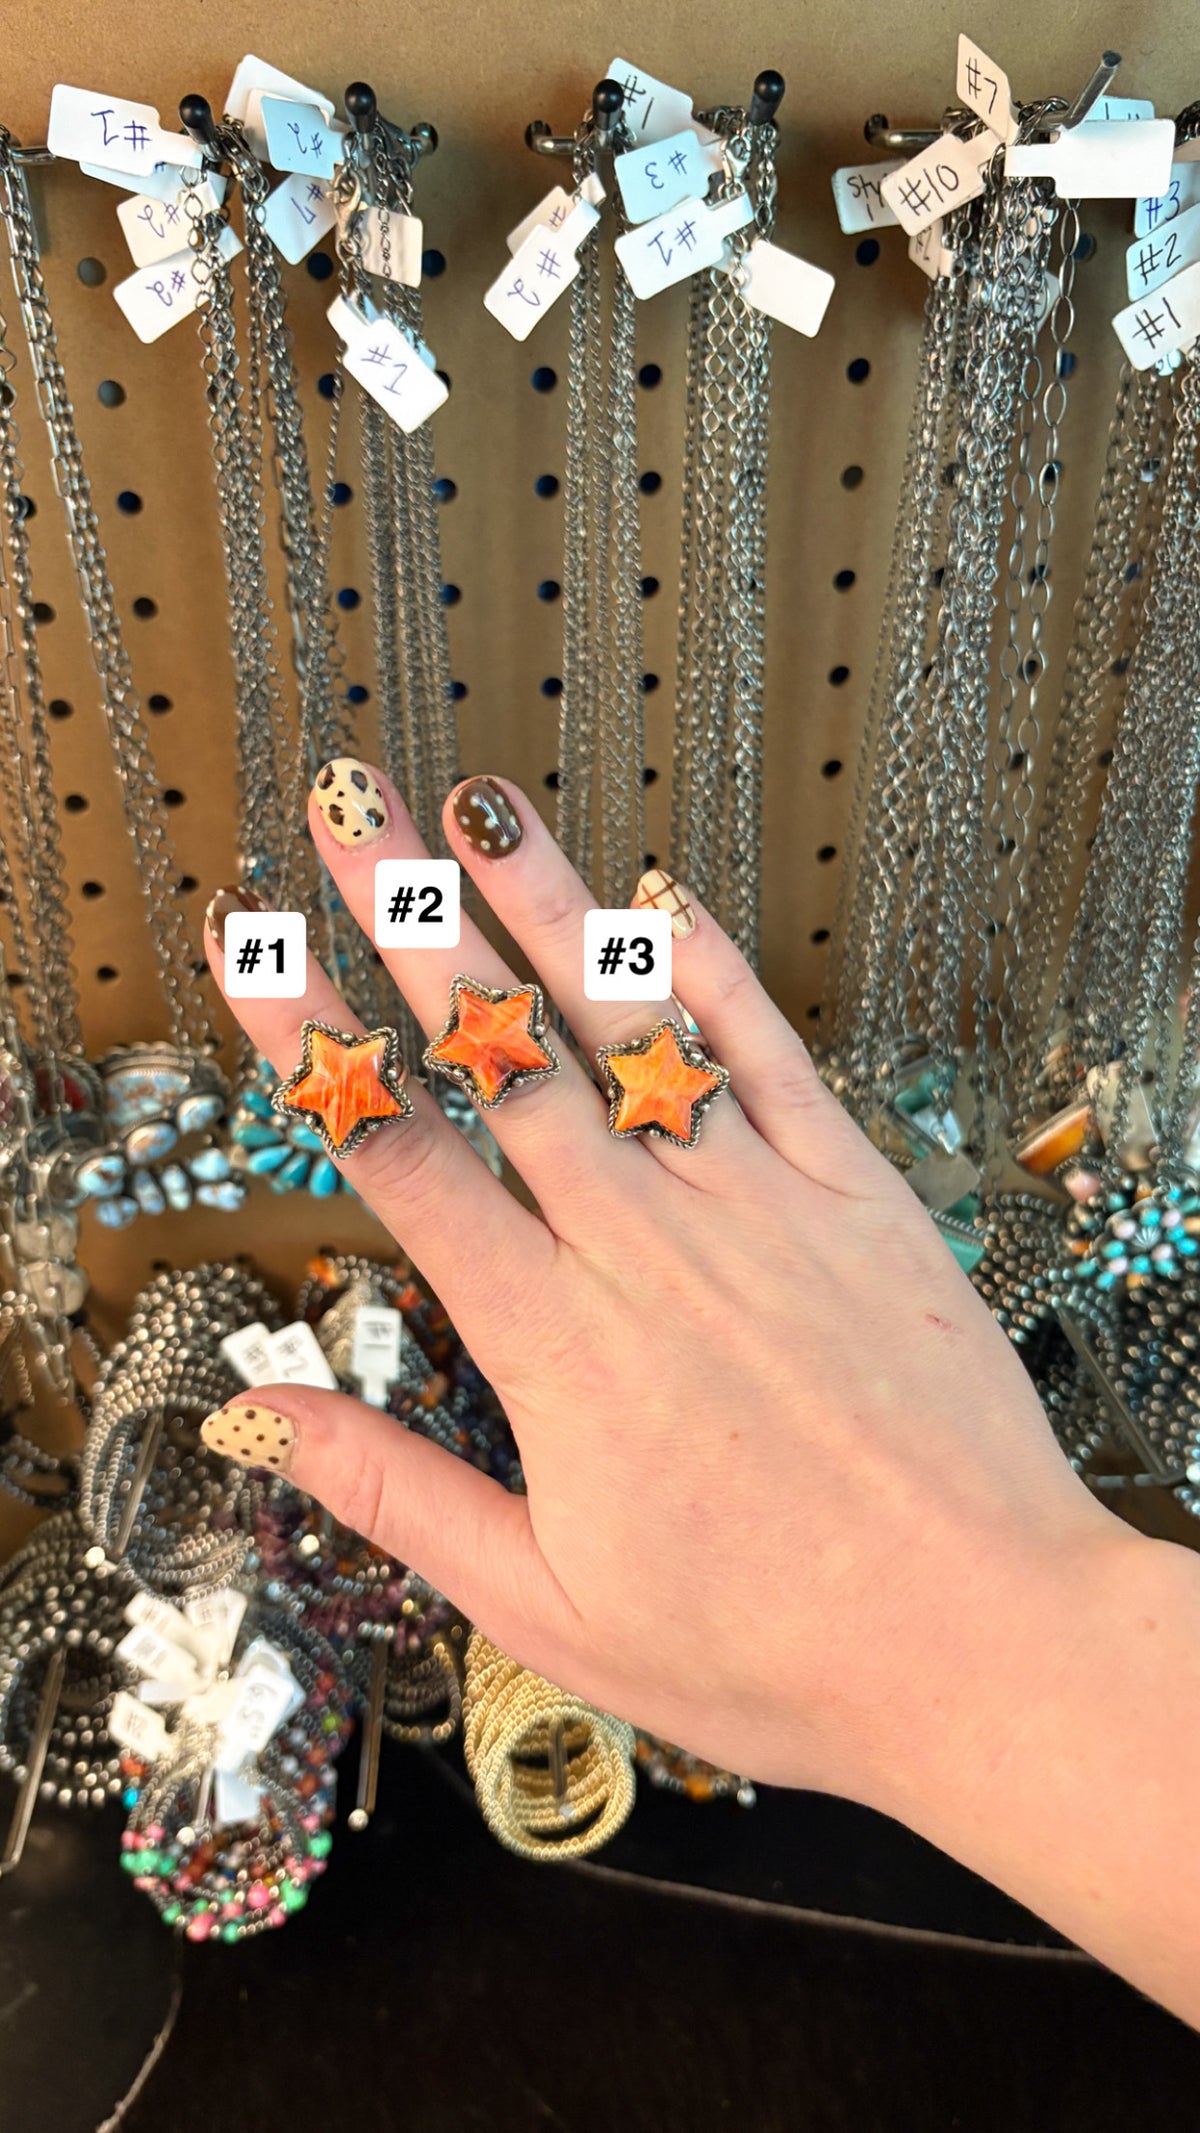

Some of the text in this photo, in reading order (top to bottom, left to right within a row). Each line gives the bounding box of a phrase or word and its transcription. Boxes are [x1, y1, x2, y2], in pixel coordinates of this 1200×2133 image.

[965, 56, 998, 115] #7
[90, 109, 153, 152] #1
[644, 150, 688, 189] #3
[898, 163, 960, 217] #10
[1142, 180, 1181, 230] #3
[647, 220, 697, 267] #1
[1133, 232, 1182, 286] #2
[1131, 296, 1182, 349] #1
